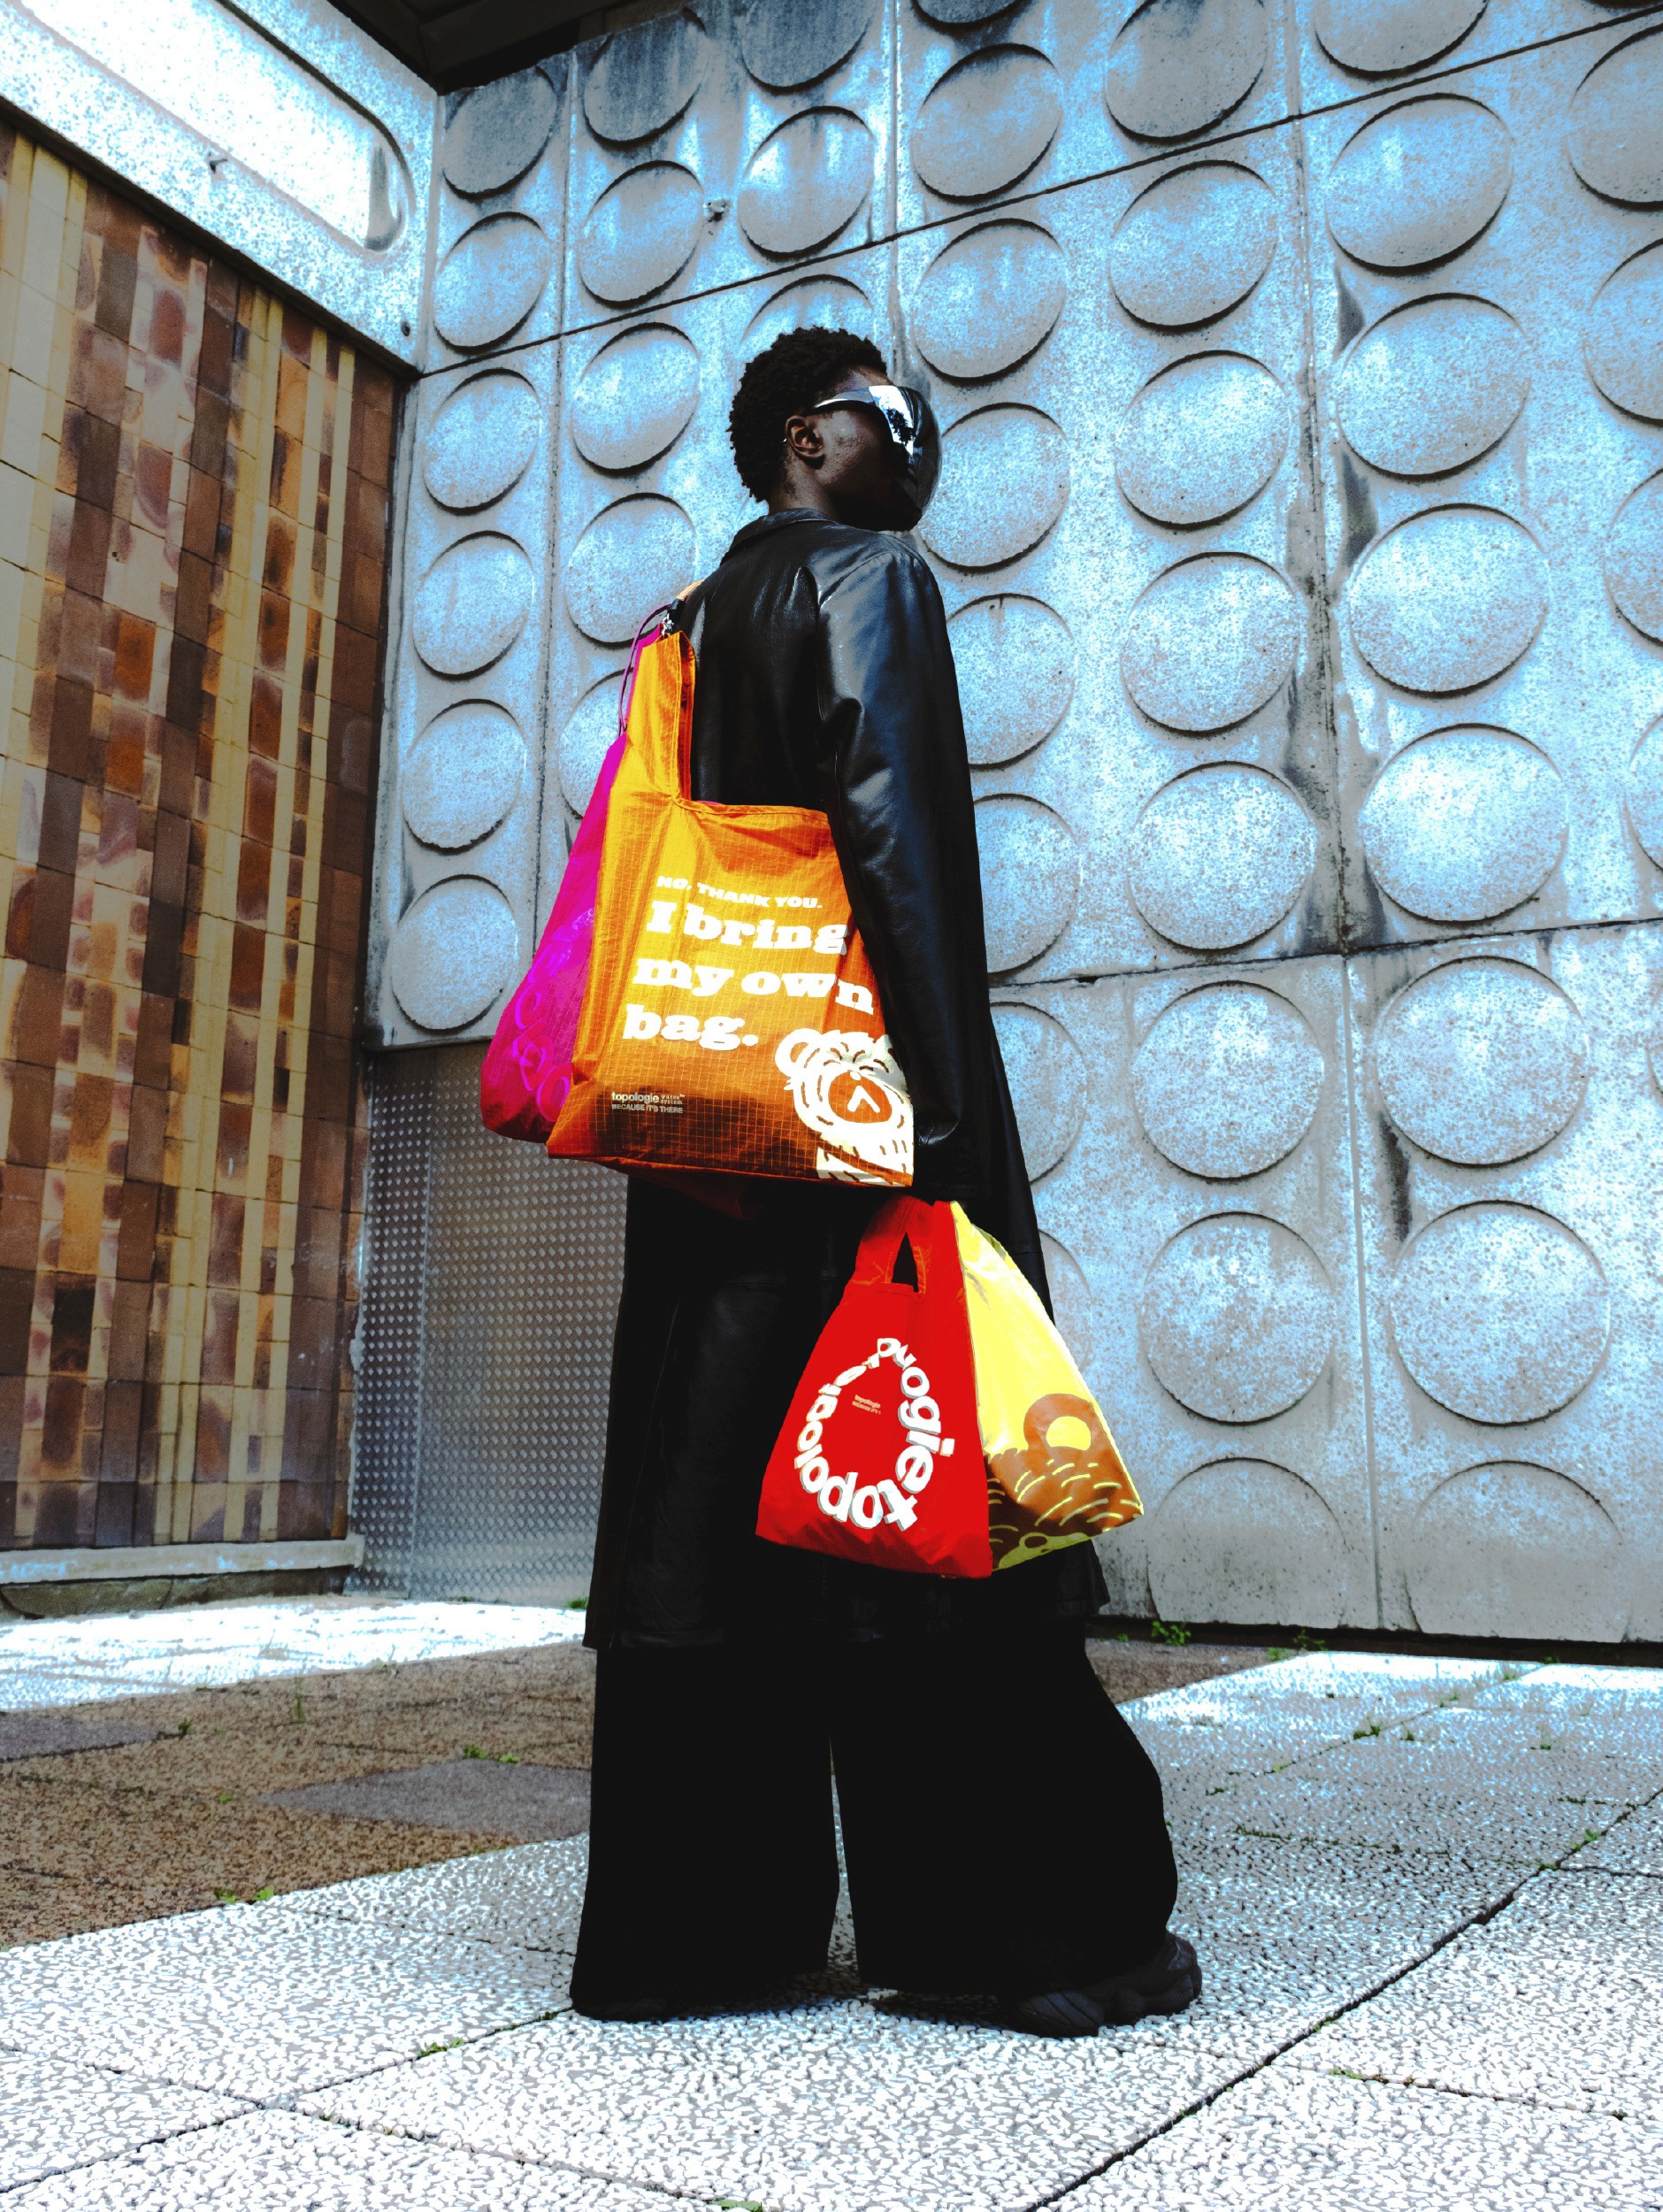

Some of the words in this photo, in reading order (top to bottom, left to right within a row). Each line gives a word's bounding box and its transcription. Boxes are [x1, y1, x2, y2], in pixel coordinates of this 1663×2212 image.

[656, 876, 692, 891] NO,
[697, 882, 772, 908] THANK
[775, 896, 823, 909] YOU.
[647, 901, 677, 933] I
[683, 902, 848, 956] bring
[632, 957, 734, 997] my
[740, 971, 874, 1015] own
[623, 1003, 759, 1051] bag.
[611, 1091, 659, 1104] topologie
[646, 1104, 659, 1113] IT'S
[660, 1105, 683, 1114] THERE
